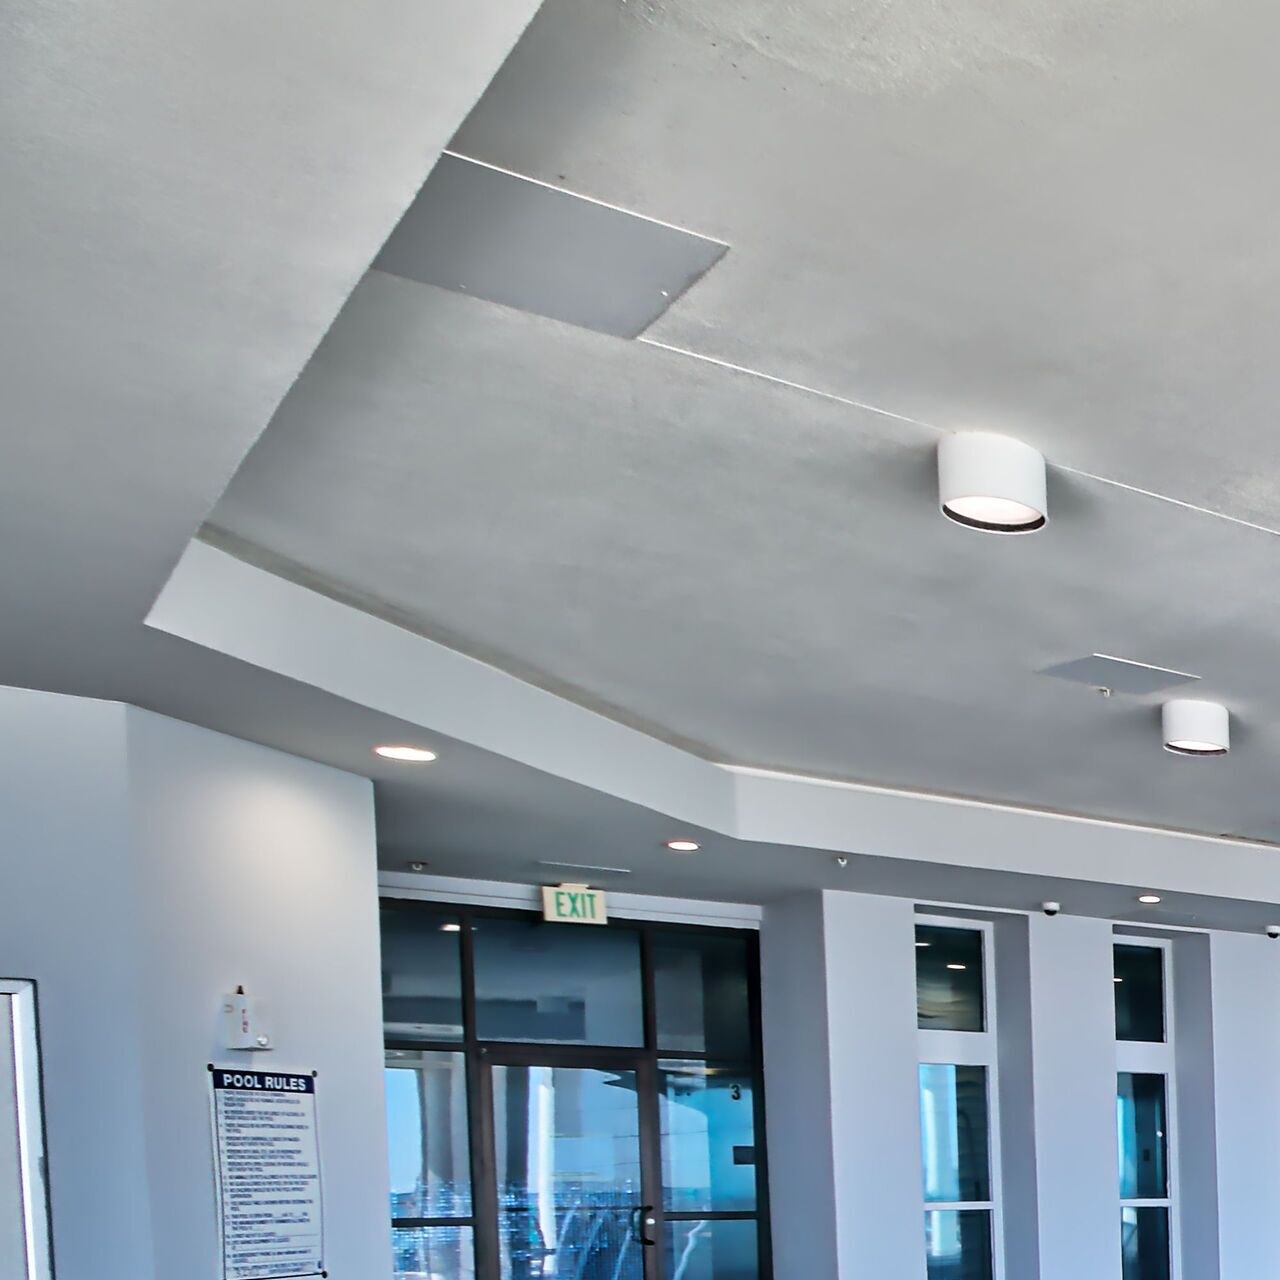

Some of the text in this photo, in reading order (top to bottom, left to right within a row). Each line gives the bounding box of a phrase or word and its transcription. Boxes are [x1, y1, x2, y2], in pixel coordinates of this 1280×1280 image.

[555, 891, 597, 919] EXIT
[222, 1073, 306, 1091] POOL RULES
[730, 1084, 741, 1100] 3
